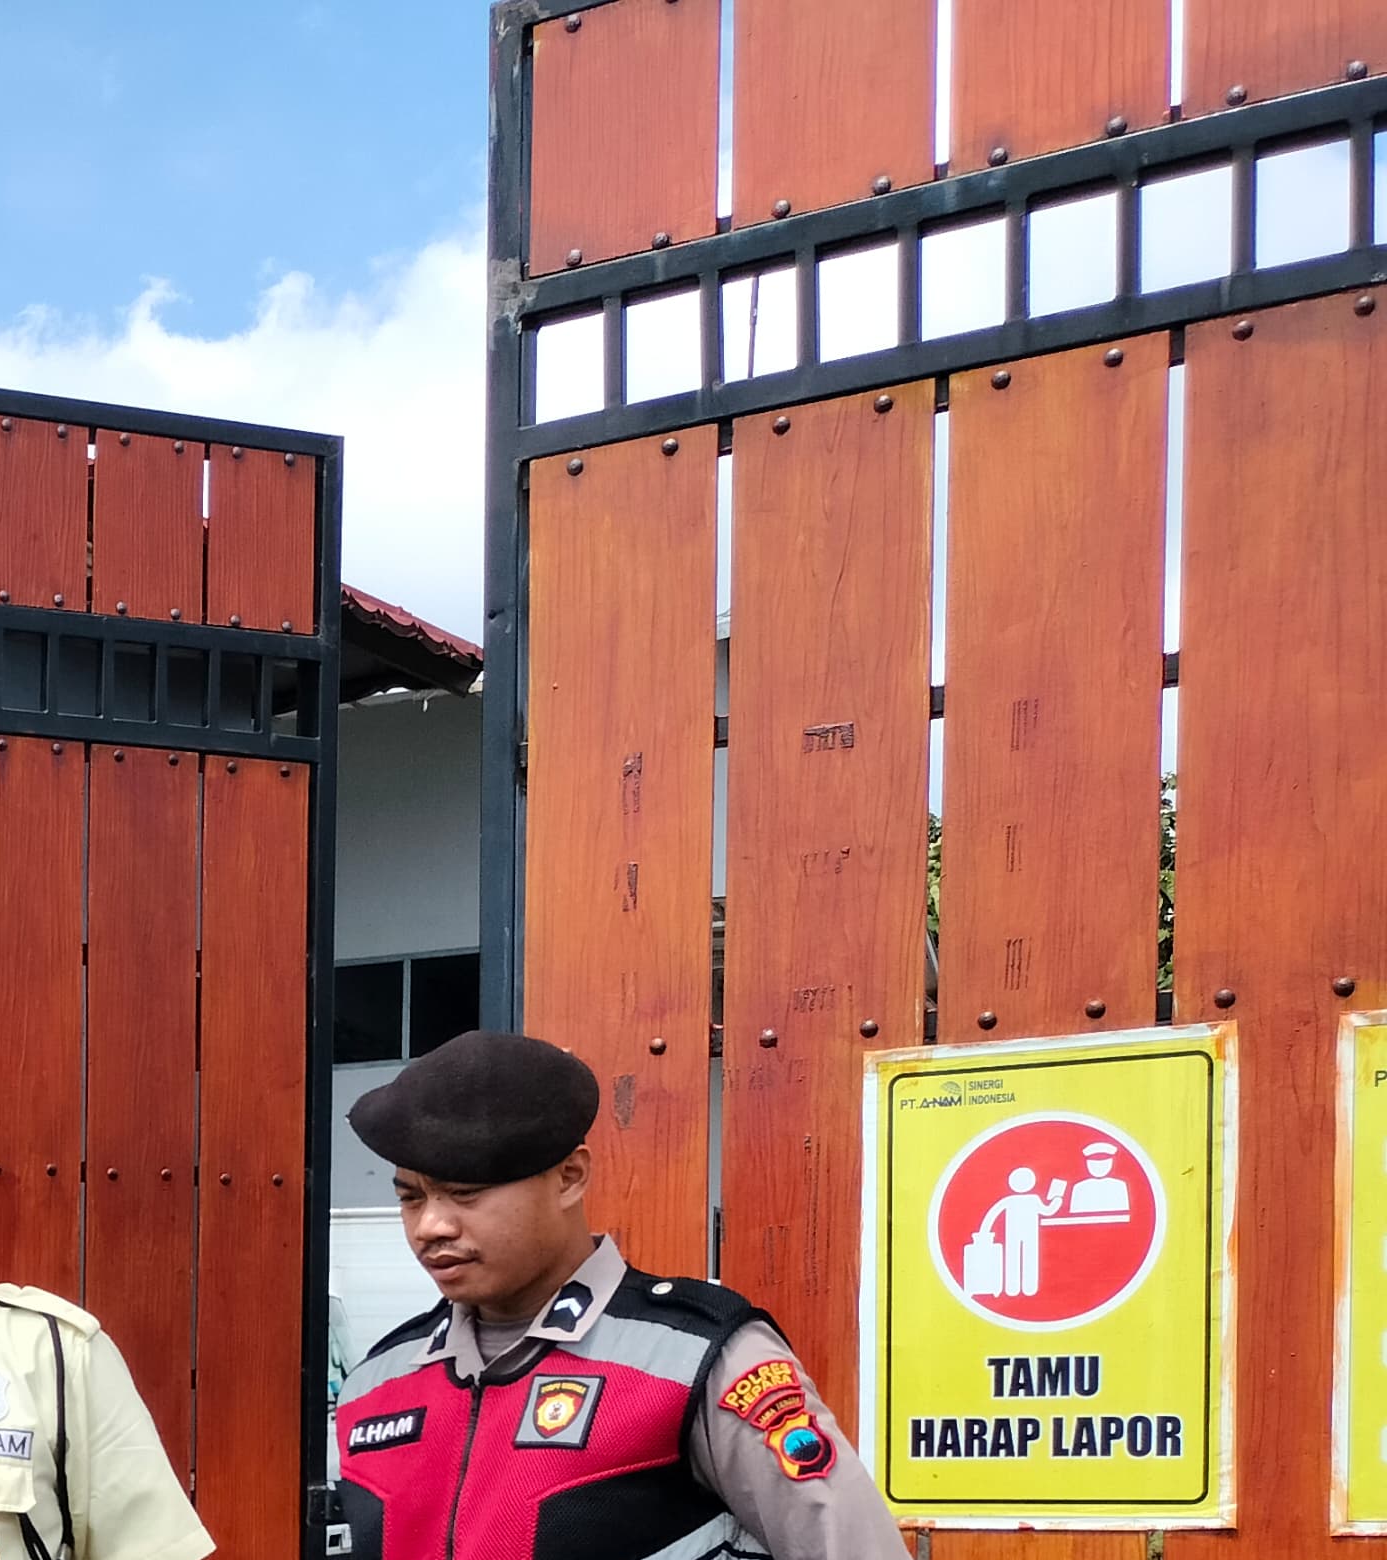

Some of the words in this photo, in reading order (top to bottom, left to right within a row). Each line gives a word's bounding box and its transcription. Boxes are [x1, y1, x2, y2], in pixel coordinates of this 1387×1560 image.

[968, 1079, 1004, 1091] SINERGI
[968, 1092, 1016, 1105] INDONESIA
[724, 1362, 792, 1408] POLRES
[737, 1374, 794, 1412] JEPARA
[987, 1355, 1100, 1398] TAMU
[349, 1415, 414, 1447] ILHAM
[910, 1417, 1041, 1458] HARAP
[1052, 1415, 1182, 1458] LAPOR
